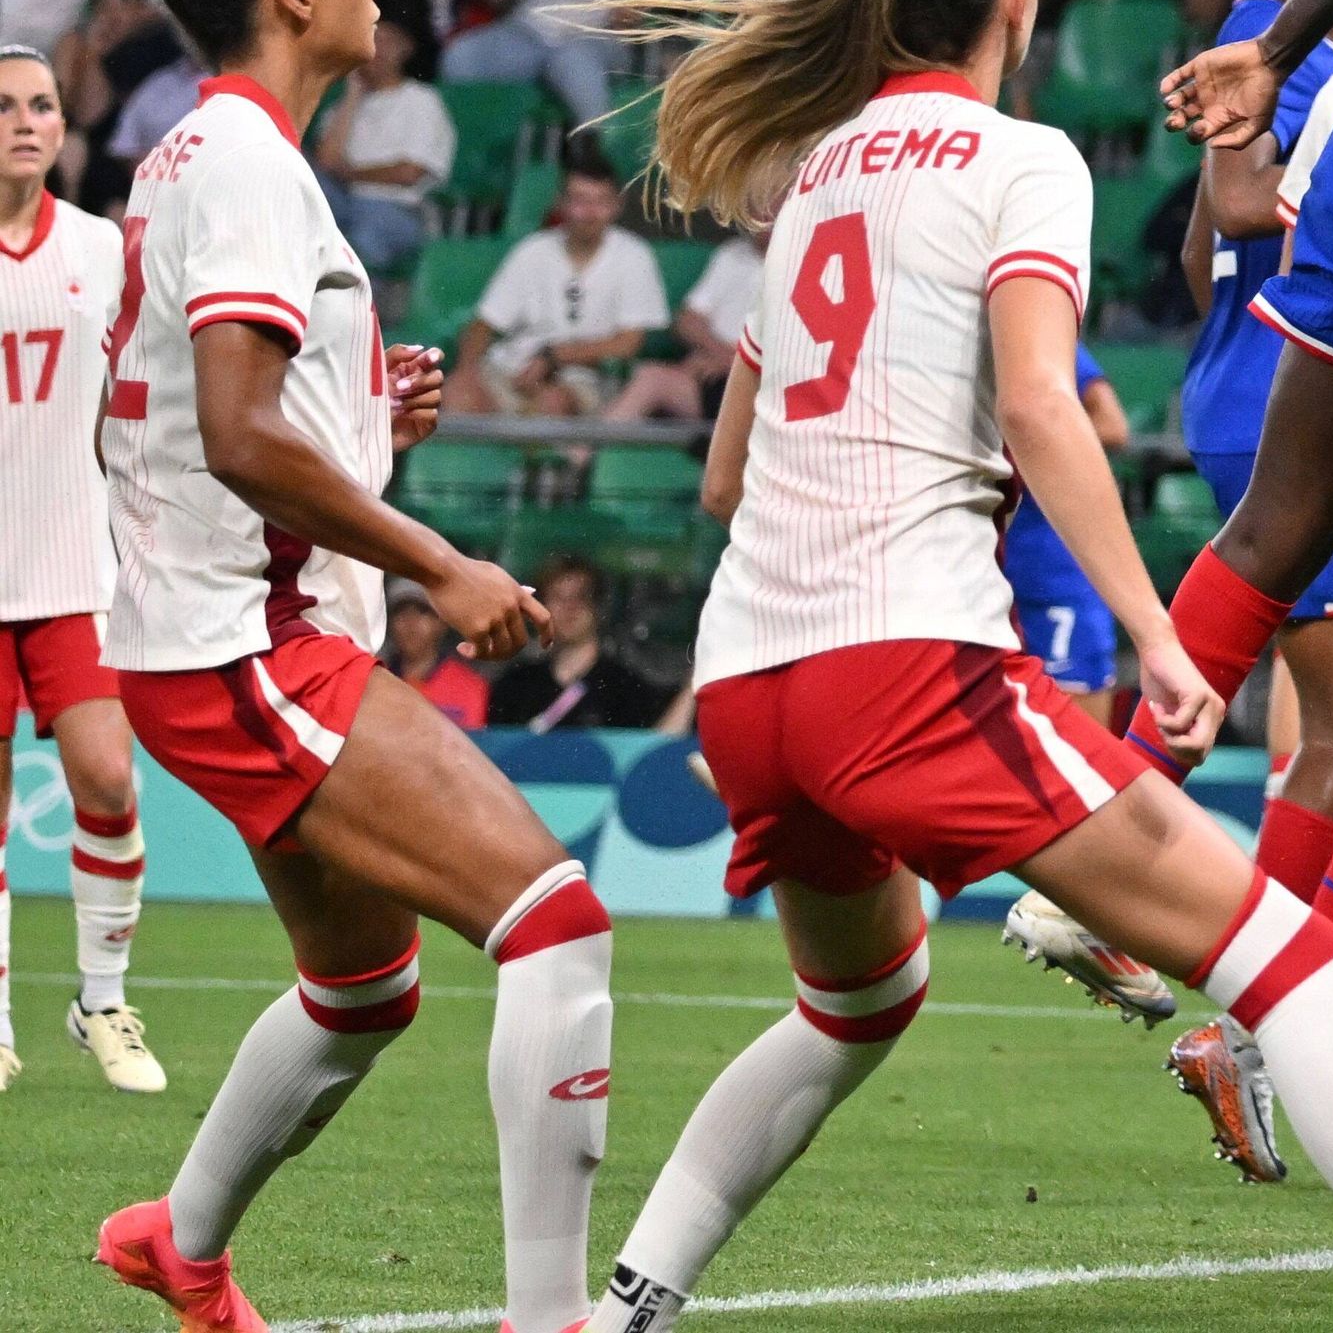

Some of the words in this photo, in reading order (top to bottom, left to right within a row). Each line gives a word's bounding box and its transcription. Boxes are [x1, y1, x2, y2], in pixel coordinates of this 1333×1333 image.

[789, 129, 981, 196] UITEMA
[784, 211, 876, 422] 9
[0, 329, 64, 404] 17
[1045, 605, 1076, 661] 7
